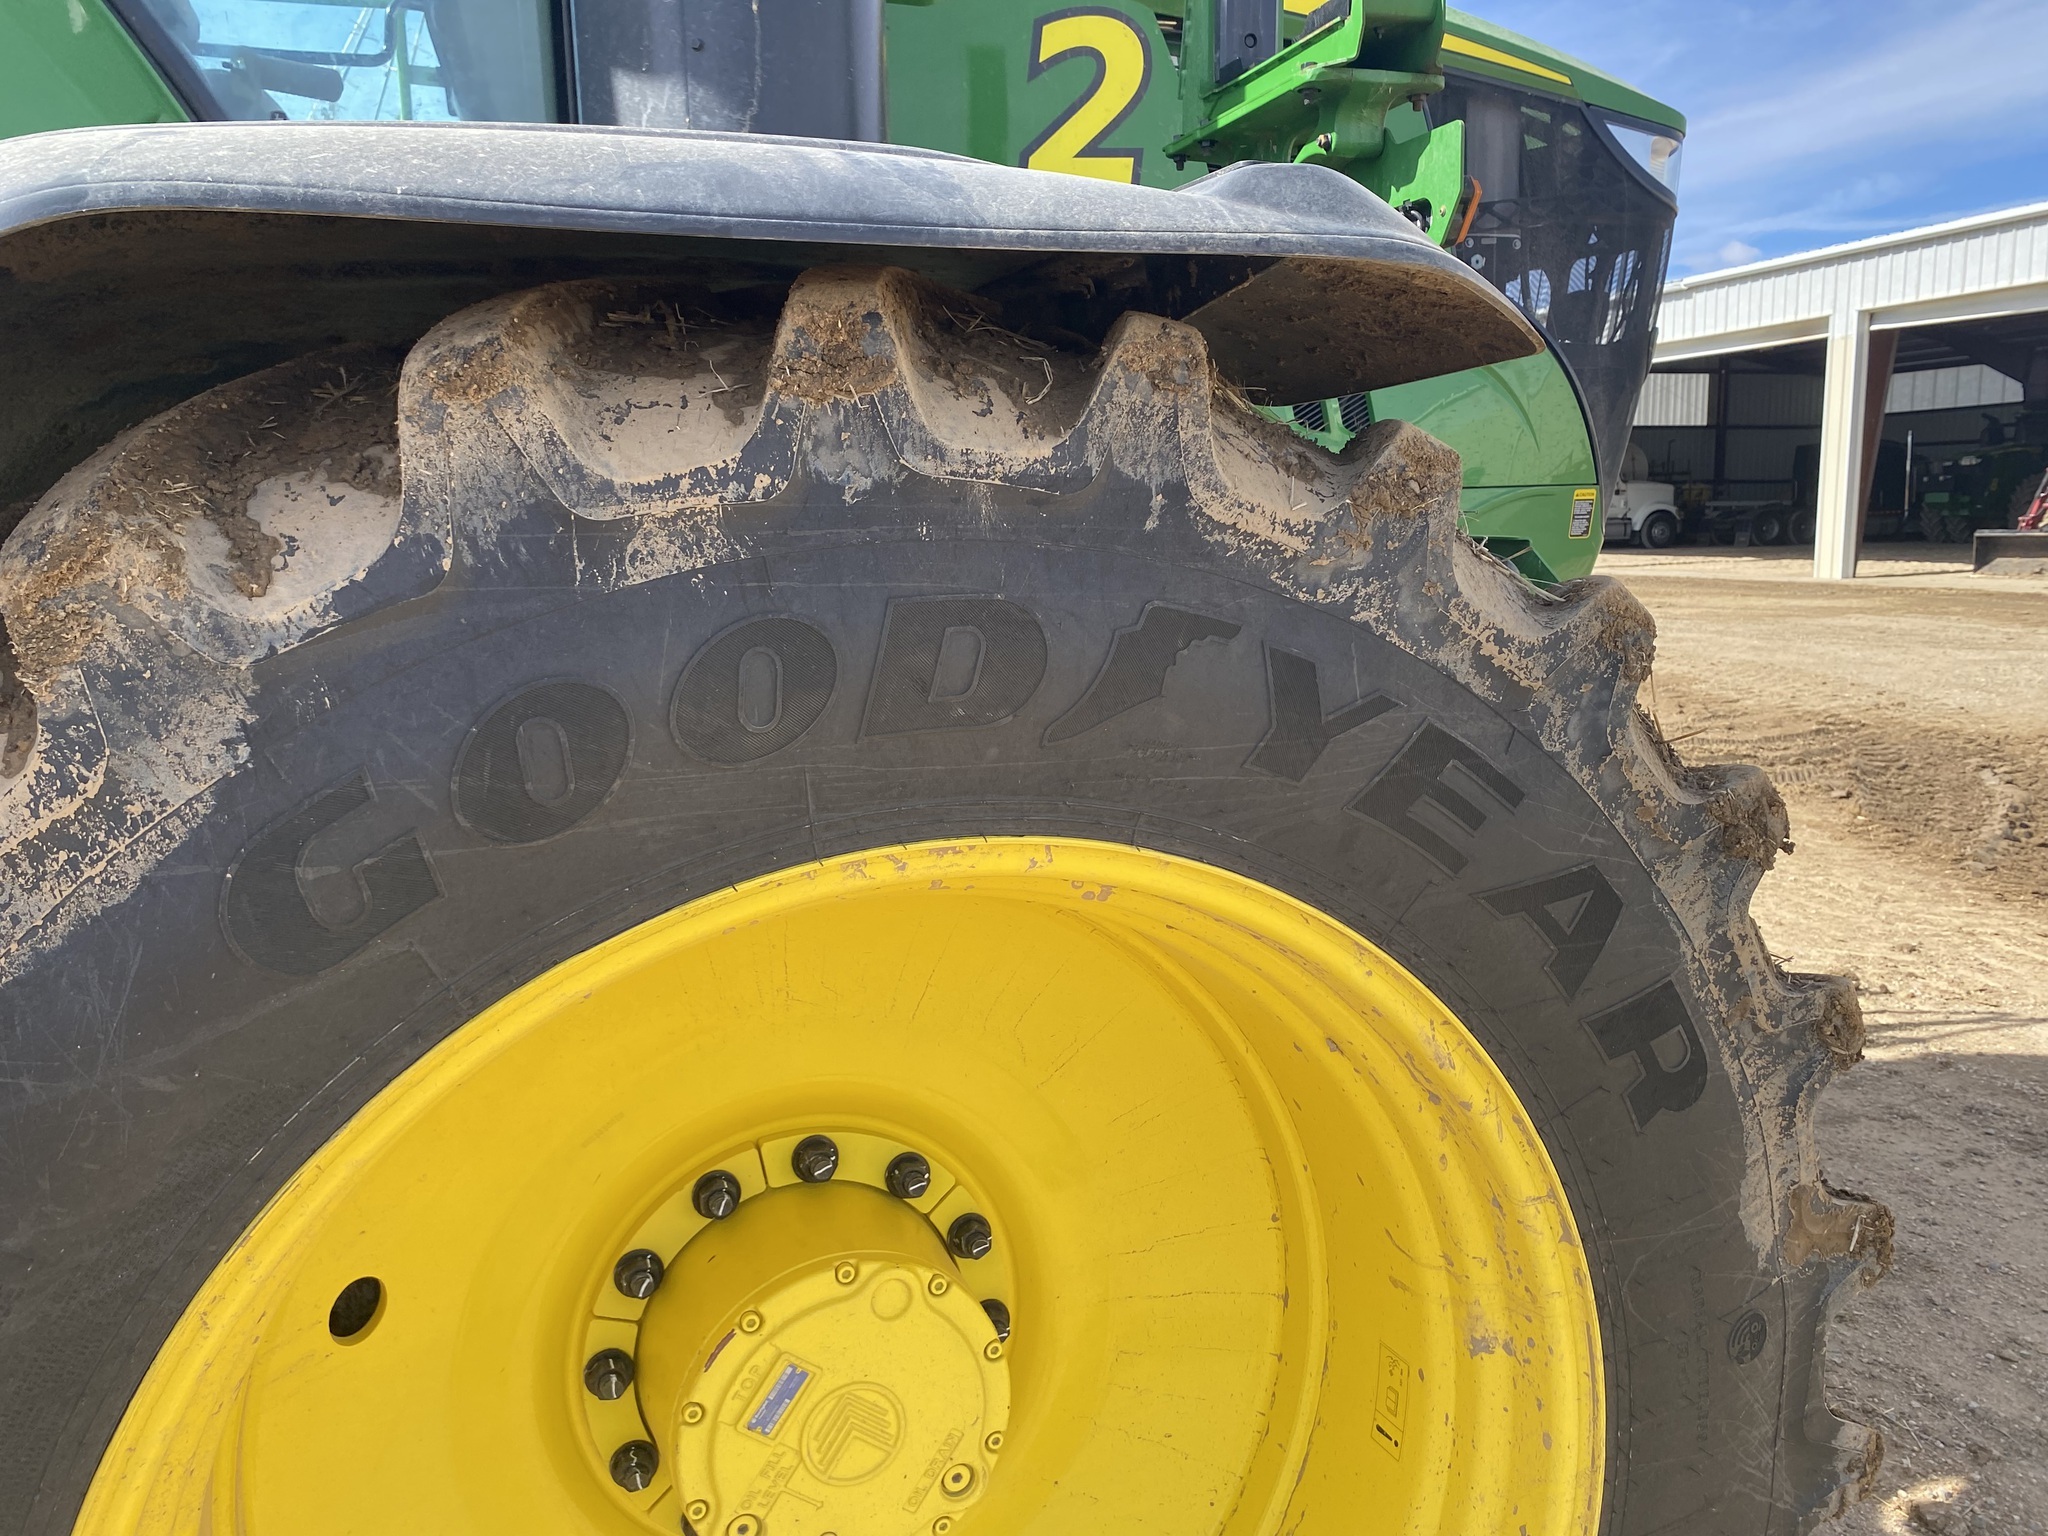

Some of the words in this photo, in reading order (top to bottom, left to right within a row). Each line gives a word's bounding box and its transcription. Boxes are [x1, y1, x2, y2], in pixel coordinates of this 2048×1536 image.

[1019, 5, 1152, 185] 2
[219, 594, 1709, 1135] GOODYEAR
[731, 1364, 761, 1401] TOP
[740, 1489, 762, 1510] OIL
[760, 1451, 786, 1479] FILL
[757, 1464, 794, 1508] LEVEL
[908, 1486, 928, 1507] OIL
[923, 1432, 961, 1479] DRAIN
